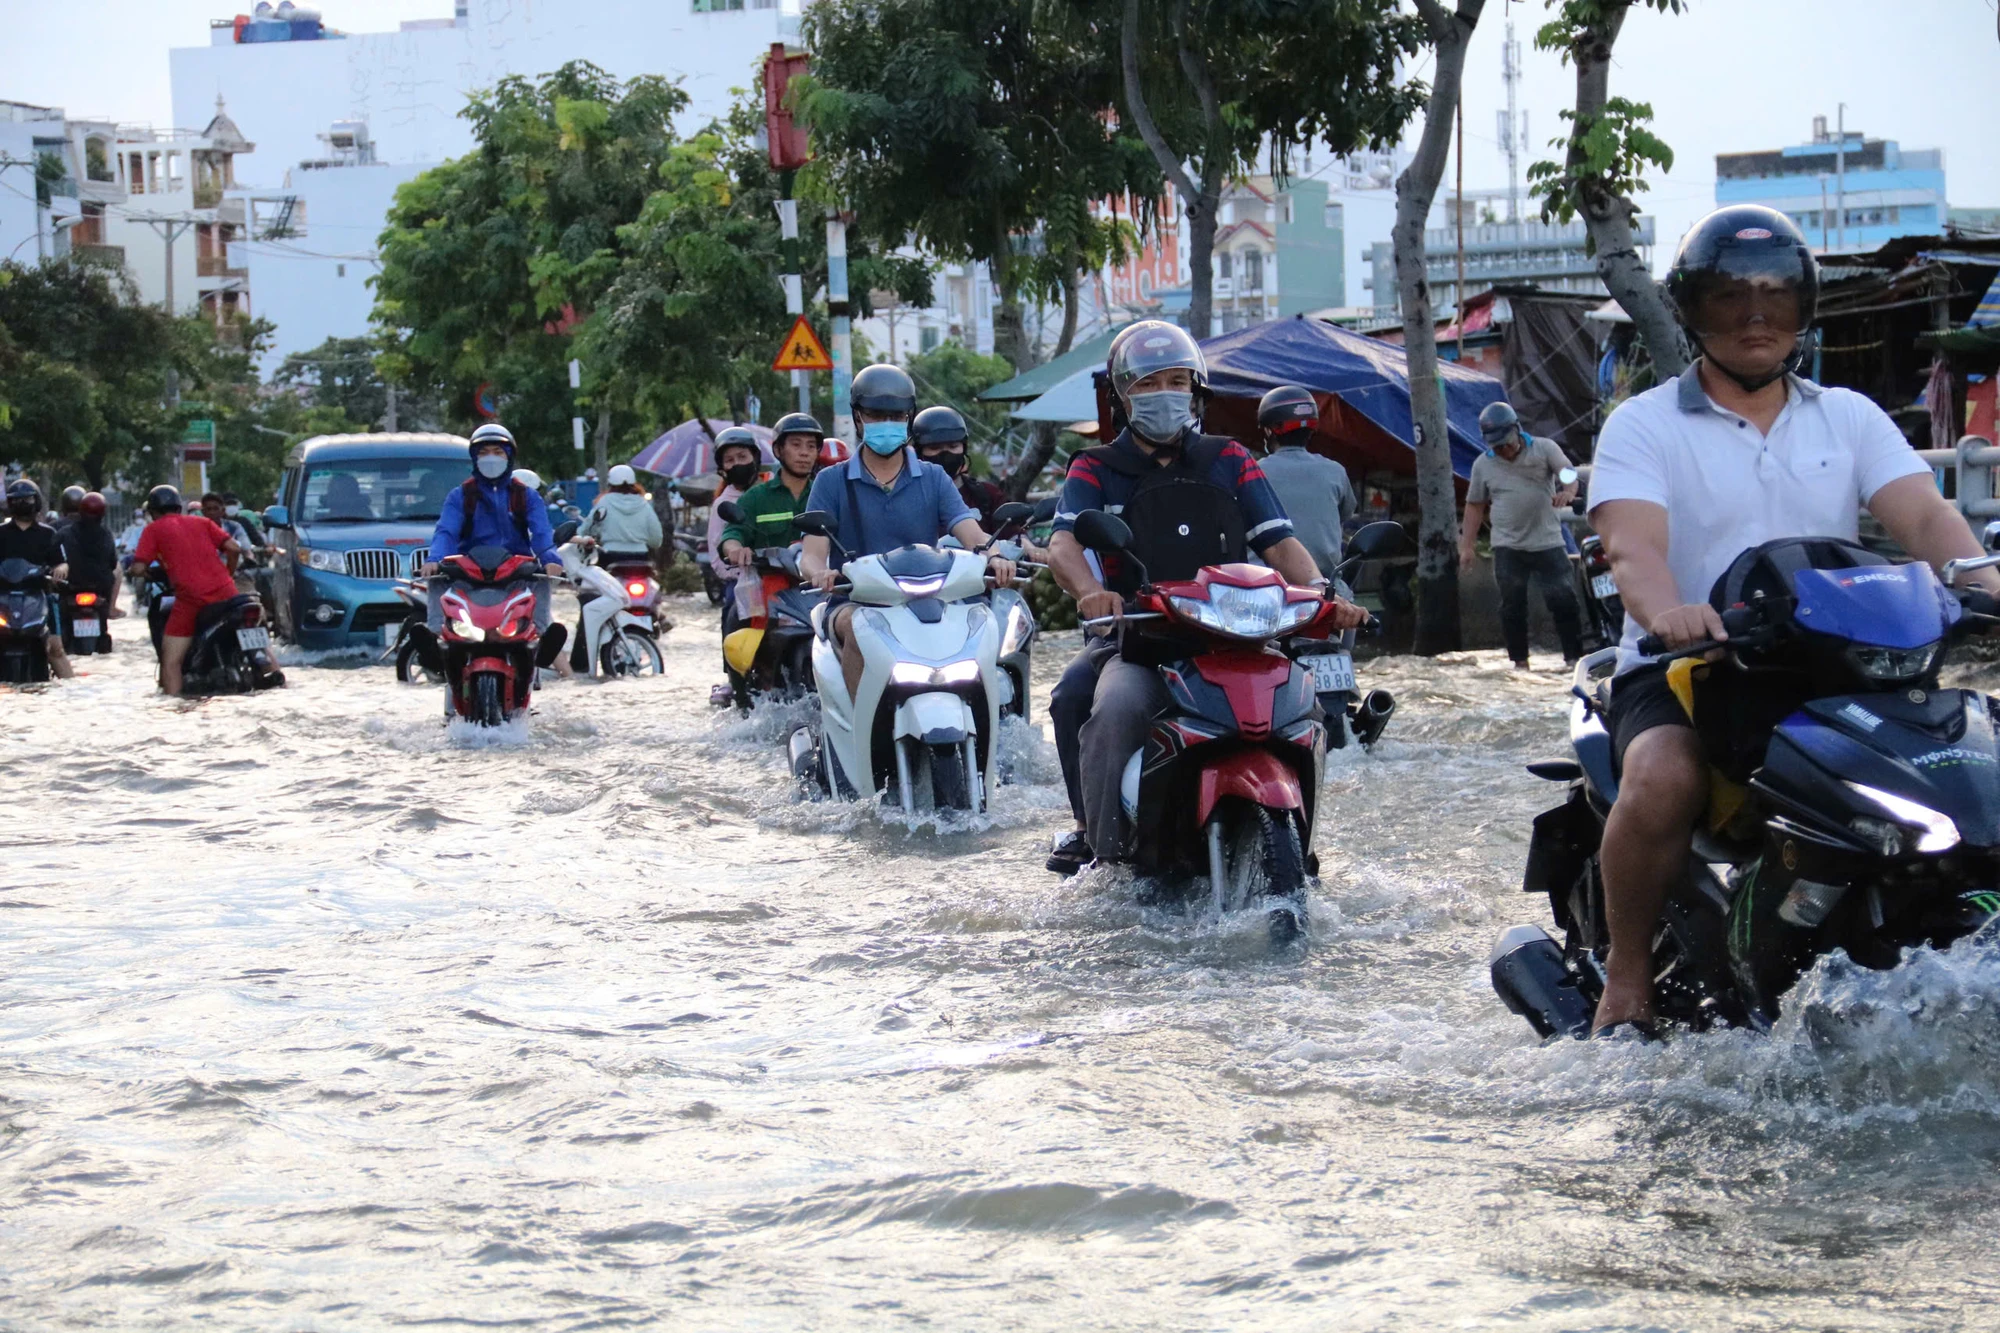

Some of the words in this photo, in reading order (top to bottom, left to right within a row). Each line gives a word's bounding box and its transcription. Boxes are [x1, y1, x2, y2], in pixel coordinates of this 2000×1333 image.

[1853, 573, 1908, 584] ENEOS
[1844, 702, 1884, 728] YAMALUBE
[1911, 747, 1997, 766] MONSTER
